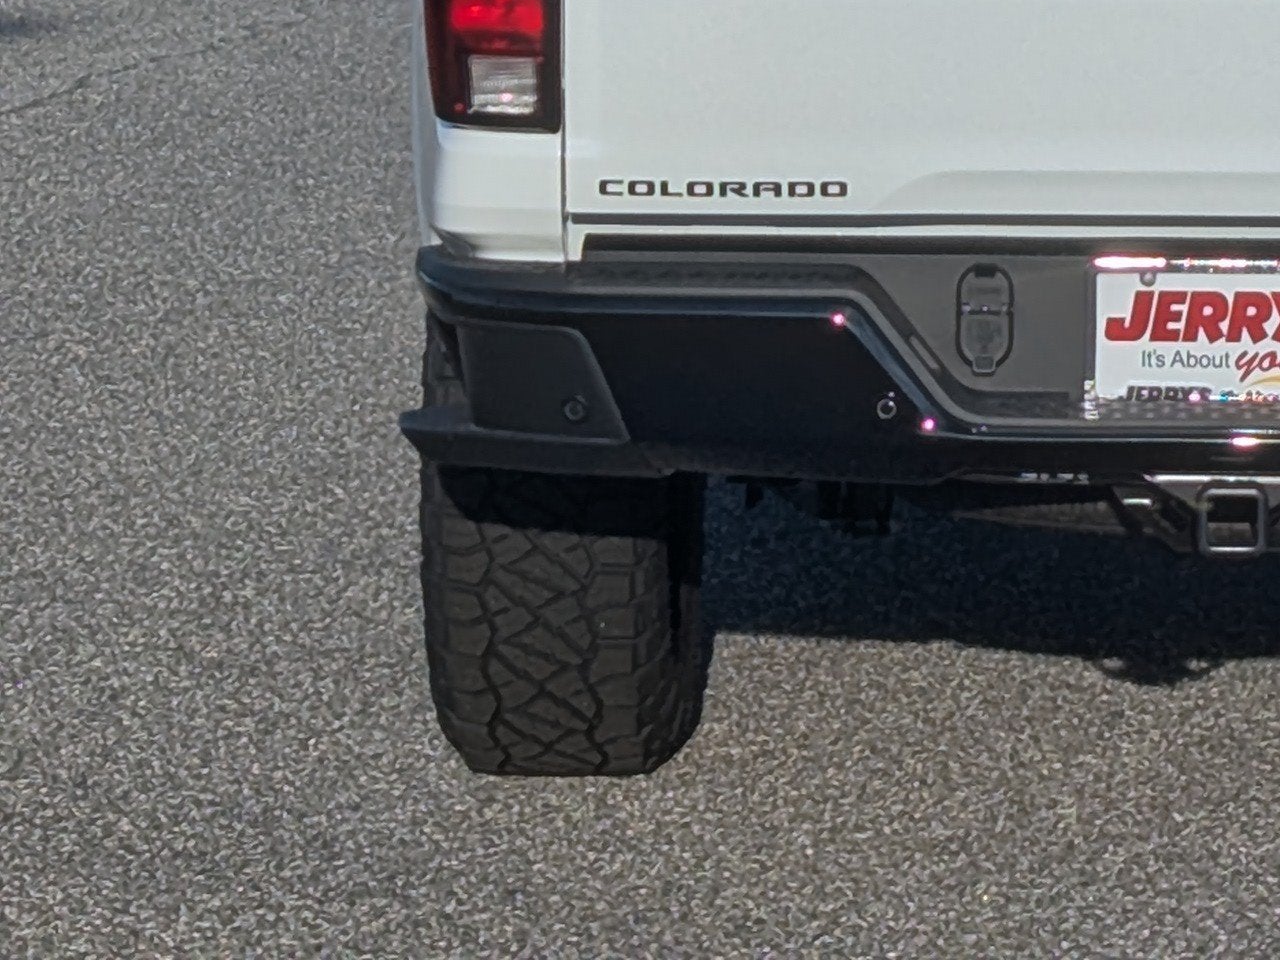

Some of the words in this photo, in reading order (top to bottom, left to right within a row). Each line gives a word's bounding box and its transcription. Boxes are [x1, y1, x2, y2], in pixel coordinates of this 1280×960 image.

[598, 179, 849, 198] COLORADO
[1141, 349, 1166, 369] It's
[1171, 349, 1230, 369] About
